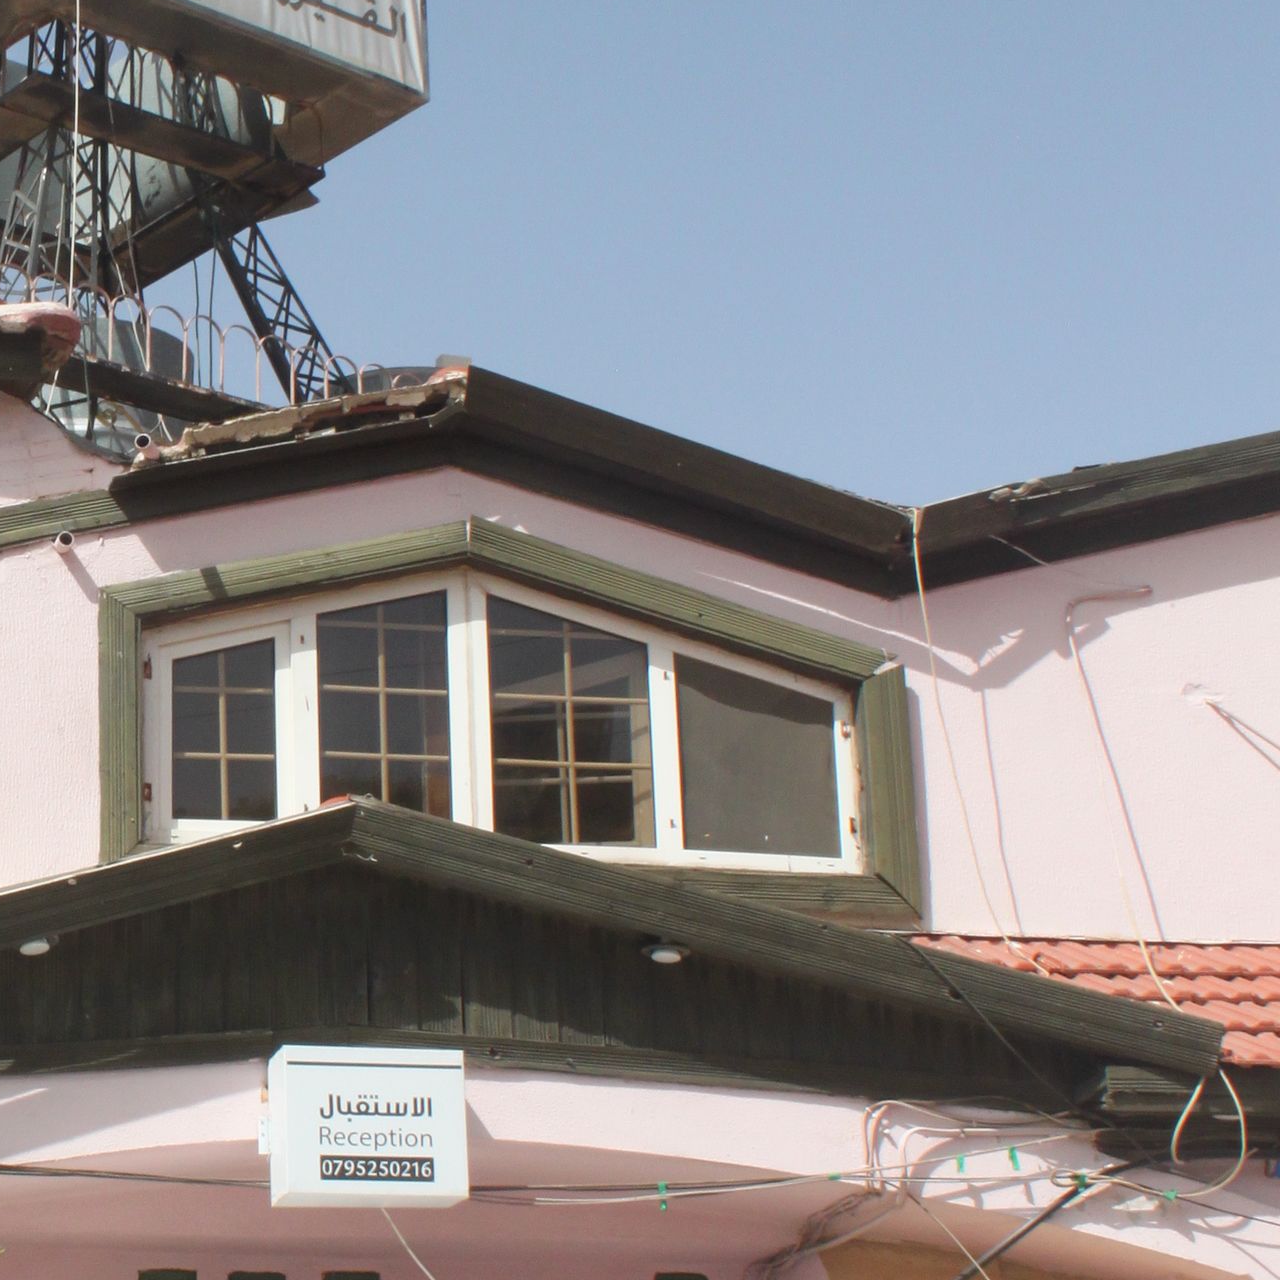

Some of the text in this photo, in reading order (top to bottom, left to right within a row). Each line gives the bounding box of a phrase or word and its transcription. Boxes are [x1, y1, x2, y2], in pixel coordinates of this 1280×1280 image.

[320, 1093, 433, 1122] الاستقبال
[319, 1126, 433, 1151] Reception
[321, 1158, 433, 1178] 0795250216
